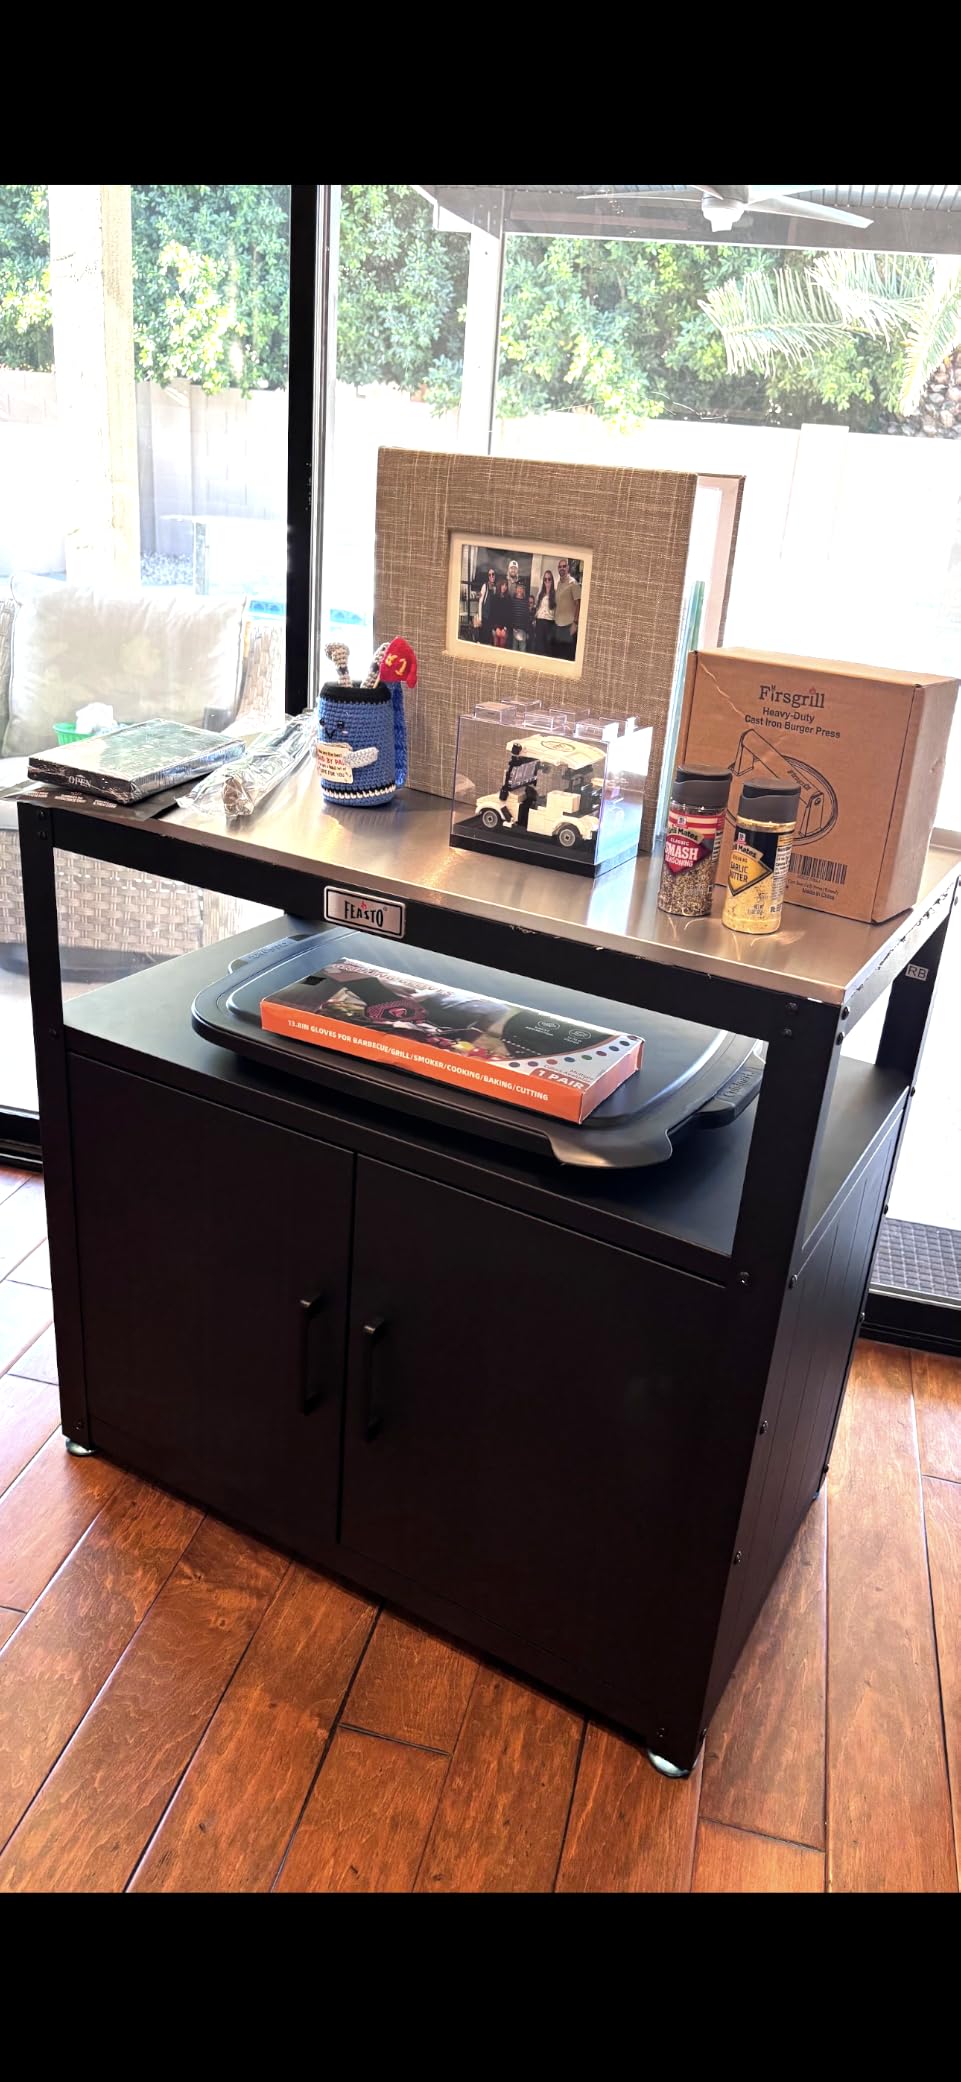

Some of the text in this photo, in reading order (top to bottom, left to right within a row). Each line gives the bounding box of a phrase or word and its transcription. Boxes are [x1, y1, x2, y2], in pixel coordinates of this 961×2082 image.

[759, 684, 825, 709] Firsgrill
[763, 707, 815, 724] Heavy-Duty
[744, 714, 841, 739] Cast Iron Burger Press
[69, 775, 92, 788] OPEN
[677, 828, 698, 841] Mates
[665, 841, 699, 861] SMASH
[344, 900, 384, 928] FEASTO
[907, 965, 927, 979] RB
[287, 1019, 310, 1032] 13.8IN
[310, 1026, 337, 1039] GLOVES
[337, 1032, 352, 1043] FOR
[538, 1069, 585, 1090] 1 PAIR
